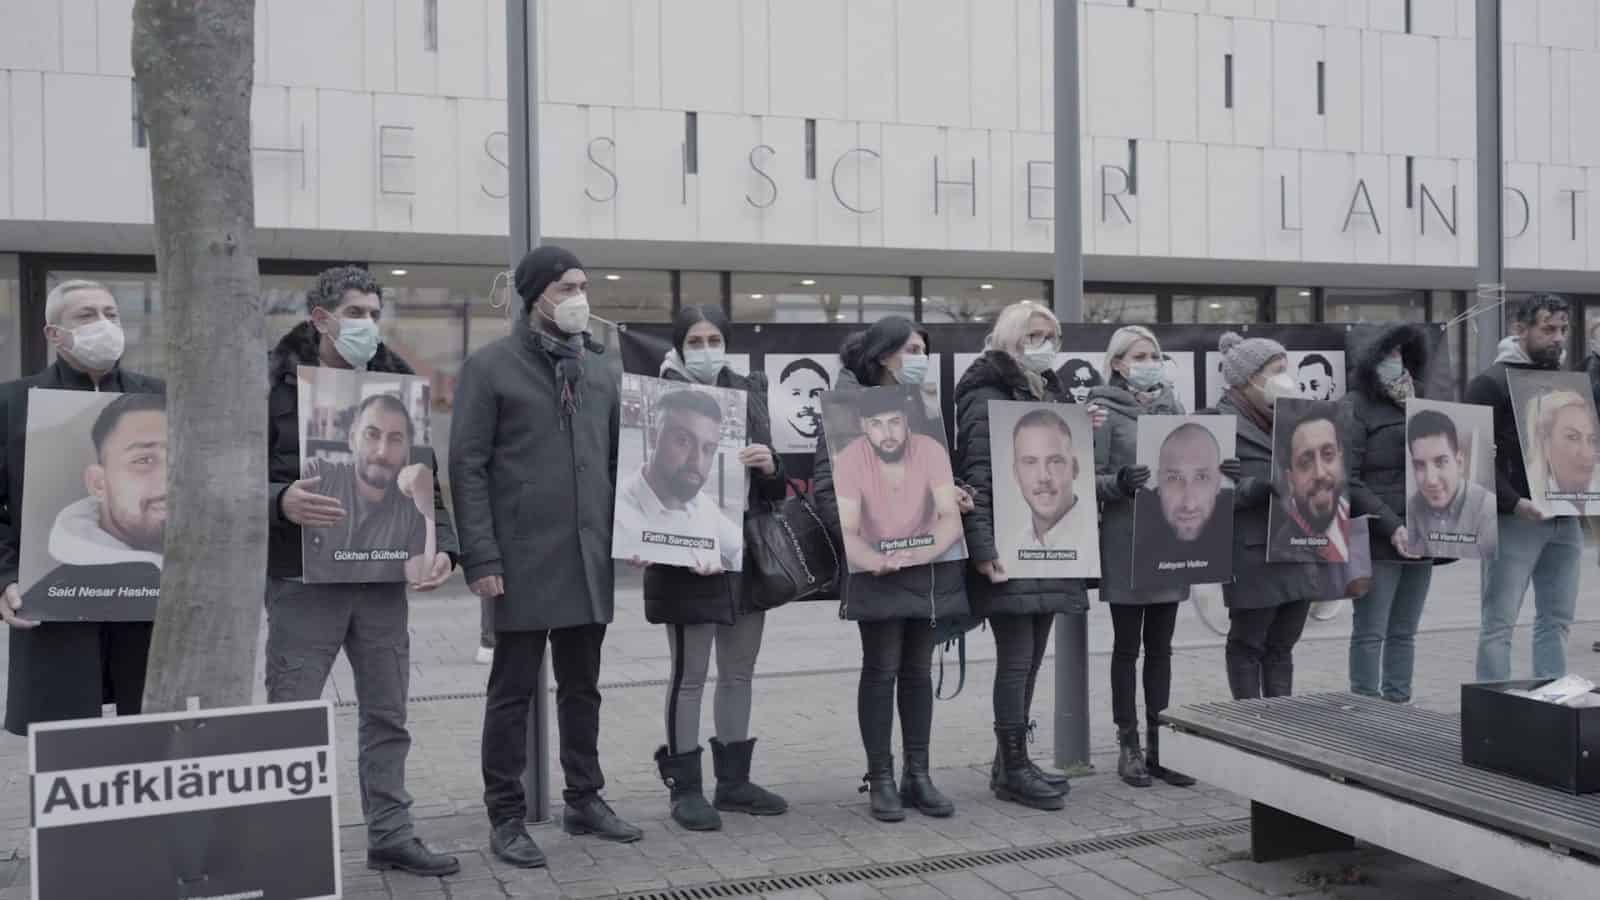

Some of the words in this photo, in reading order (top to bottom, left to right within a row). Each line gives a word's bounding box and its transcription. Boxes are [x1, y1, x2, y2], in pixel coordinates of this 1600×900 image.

[253, 122, 1132, 226] HESSISCHER
[334, 549, 369, 561] Gökhan
[47, 585, 77, 598] Said
[78, 586, 116, 598] Nesar
[42, 750, 328, 815] Aufklärung!
